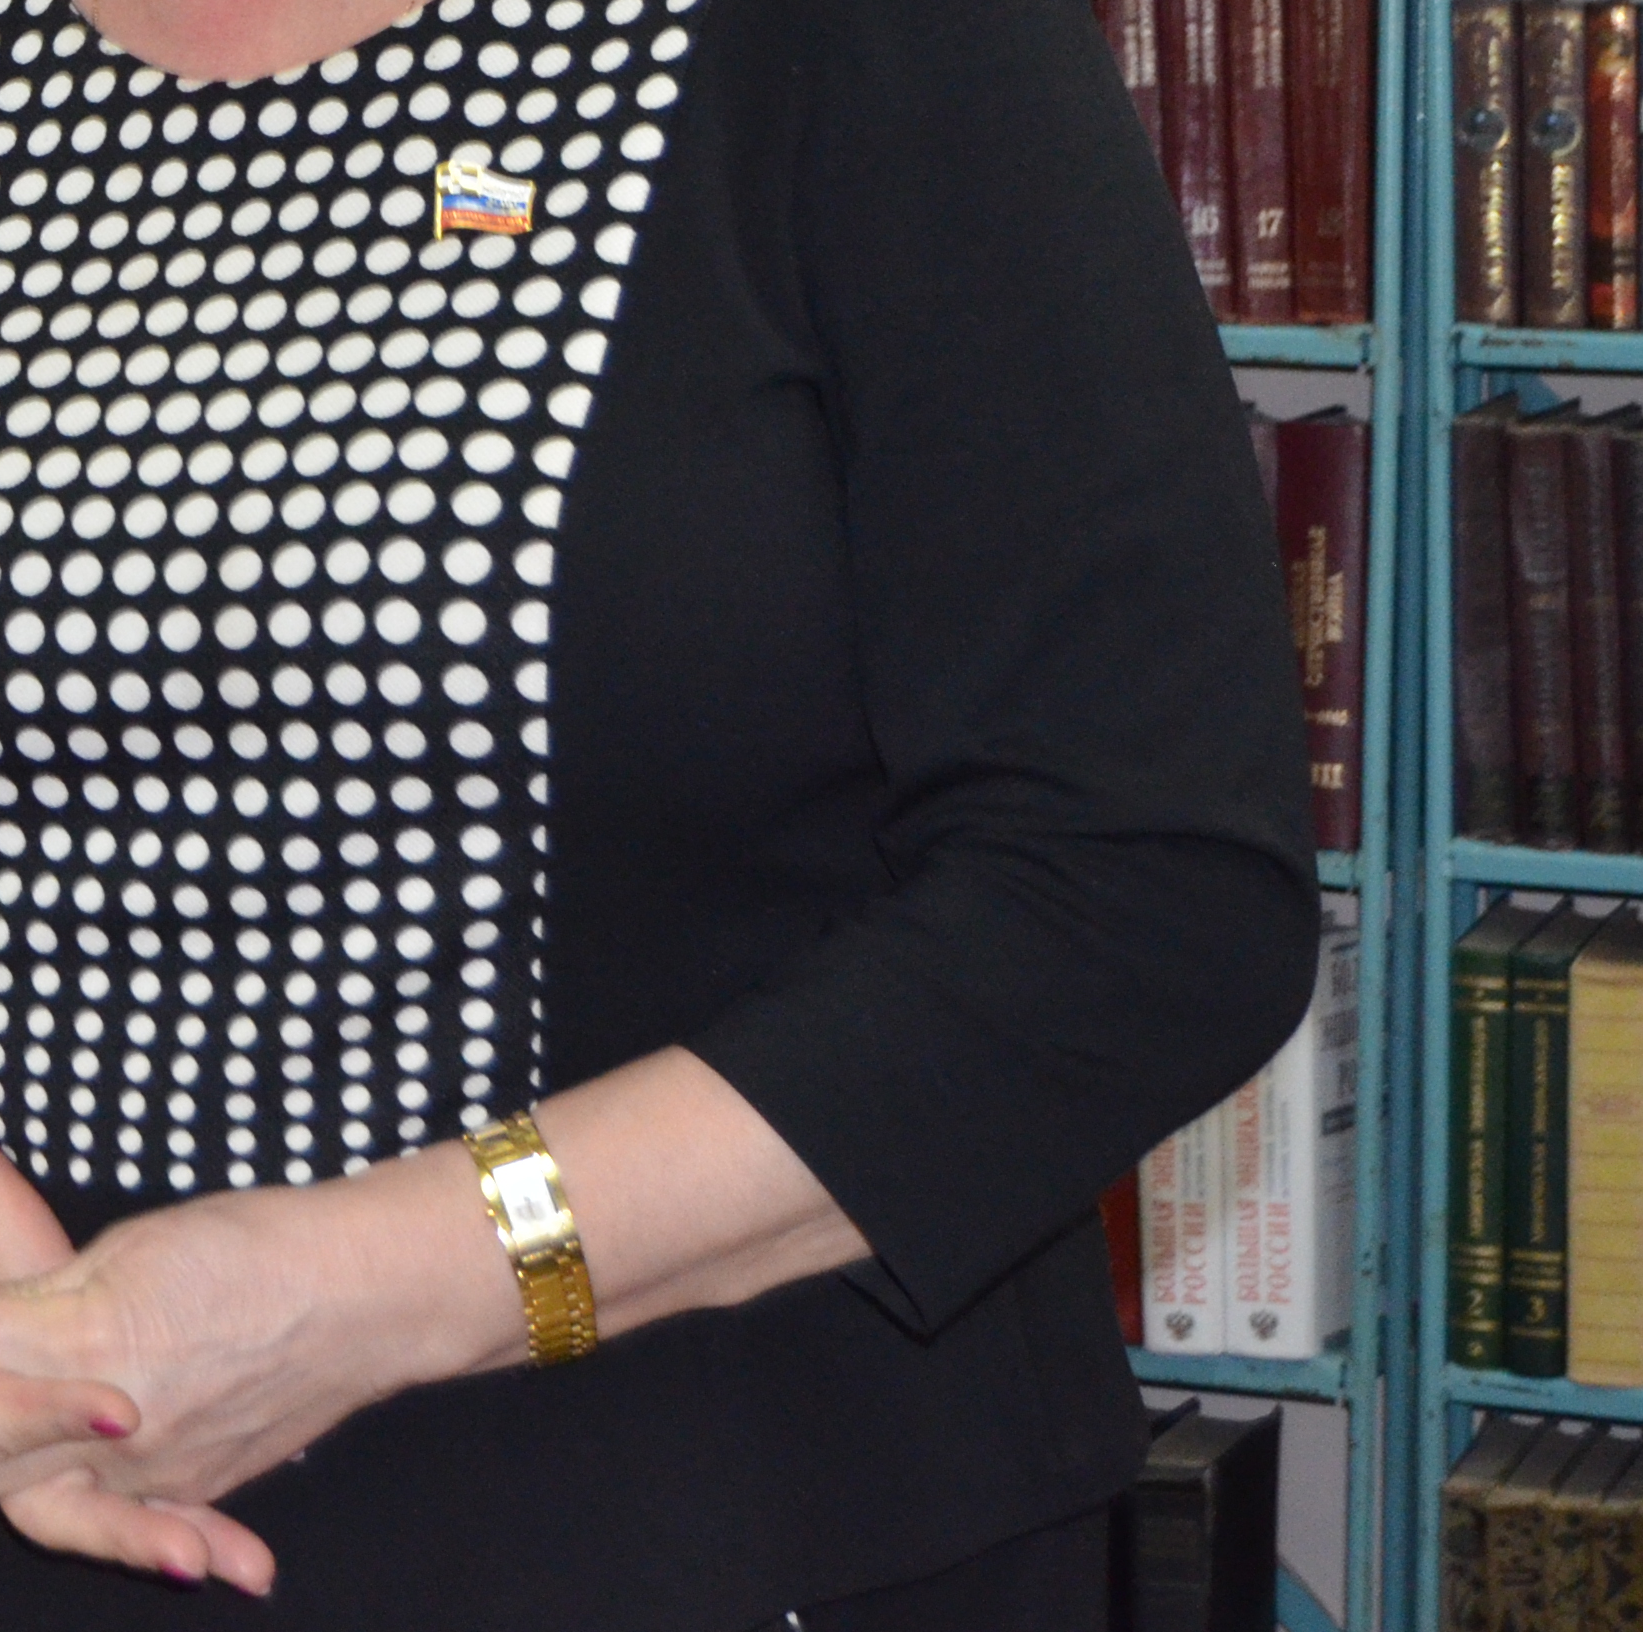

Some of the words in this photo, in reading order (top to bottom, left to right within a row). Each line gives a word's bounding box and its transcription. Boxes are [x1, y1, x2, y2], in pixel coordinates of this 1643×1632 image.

[1256, 207, 1285, 239] 17
[1150, 1200, 1178, 1304] БОЛЬШАЯ
[1180, 1201, 1207, 1306] РОССИИ
[1235, 1198, 1261, 1302] БОЛЬШАЯ
[1265, 1201, 1291, 1305] РОССИИ
